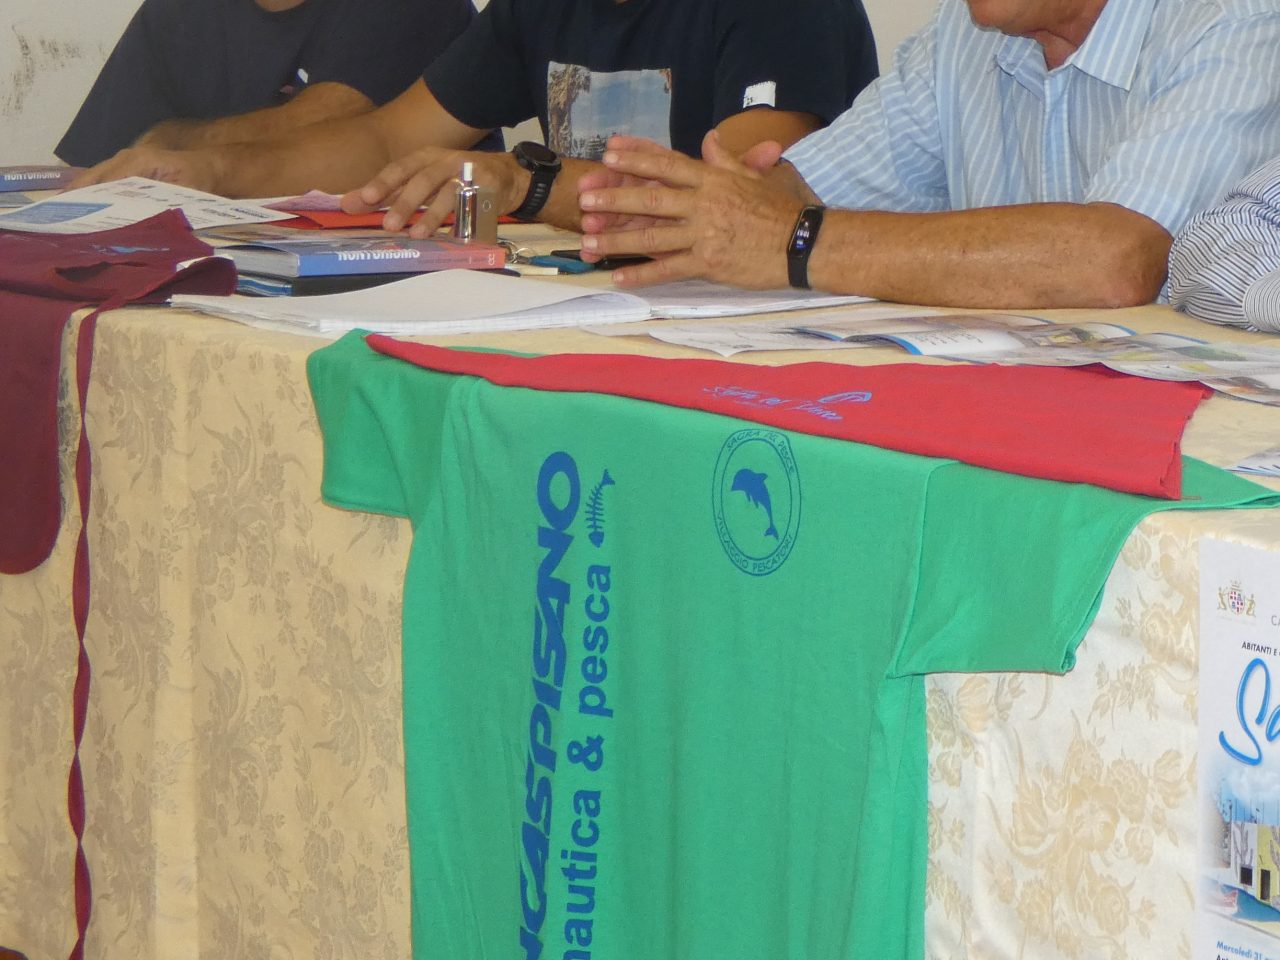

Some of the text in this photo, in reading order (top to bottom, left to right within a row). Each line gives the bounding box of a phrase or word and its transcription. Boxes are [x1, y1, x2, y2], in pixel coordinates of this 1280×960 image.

[752, 534, 793, 572] PESCATORI
[578, 564, 615, 719] pesca
[1241, 640, 1272, 656] ABITANTI
[1273, 648, 1277, 656] E
[567, 734, 606, 772] &
